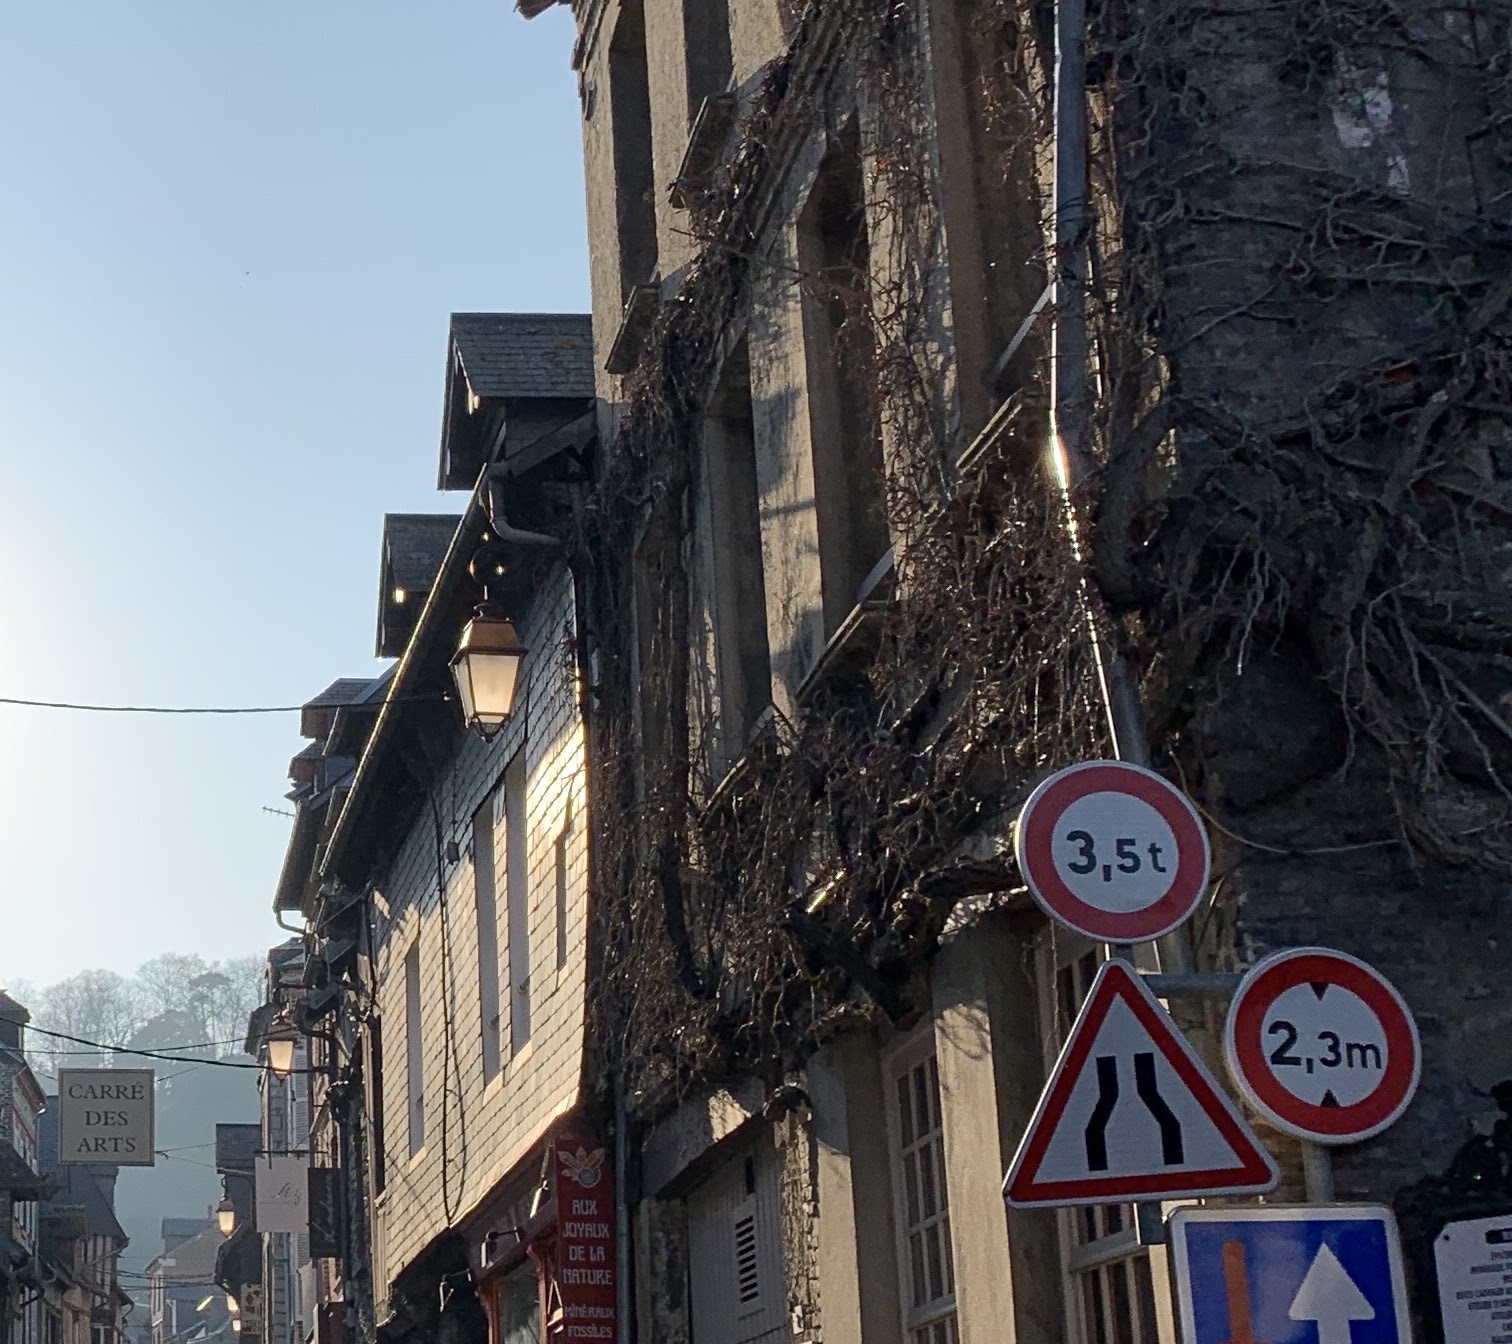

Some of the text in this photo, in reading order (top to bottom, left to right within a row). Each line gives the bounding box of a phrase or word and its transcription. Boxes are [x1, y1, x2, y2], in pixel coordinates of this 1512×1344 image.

[1267, 1020, 1383, 1075] 2,3m
[68, 1081, 145, 1100] CARRÉ
[84, 1110, 129, 1127] DES
[76, 1137, 136, 1153] ARTS
[572, 1199, 598, 1216] AUX
[562, 1222, 610, 1239] JOYAUX
[569, 1245, 606, 1262] DE LA
[562, 1268, 614, 1286] NATURE
[567, 1323, 613, 1339] FOSSILES
